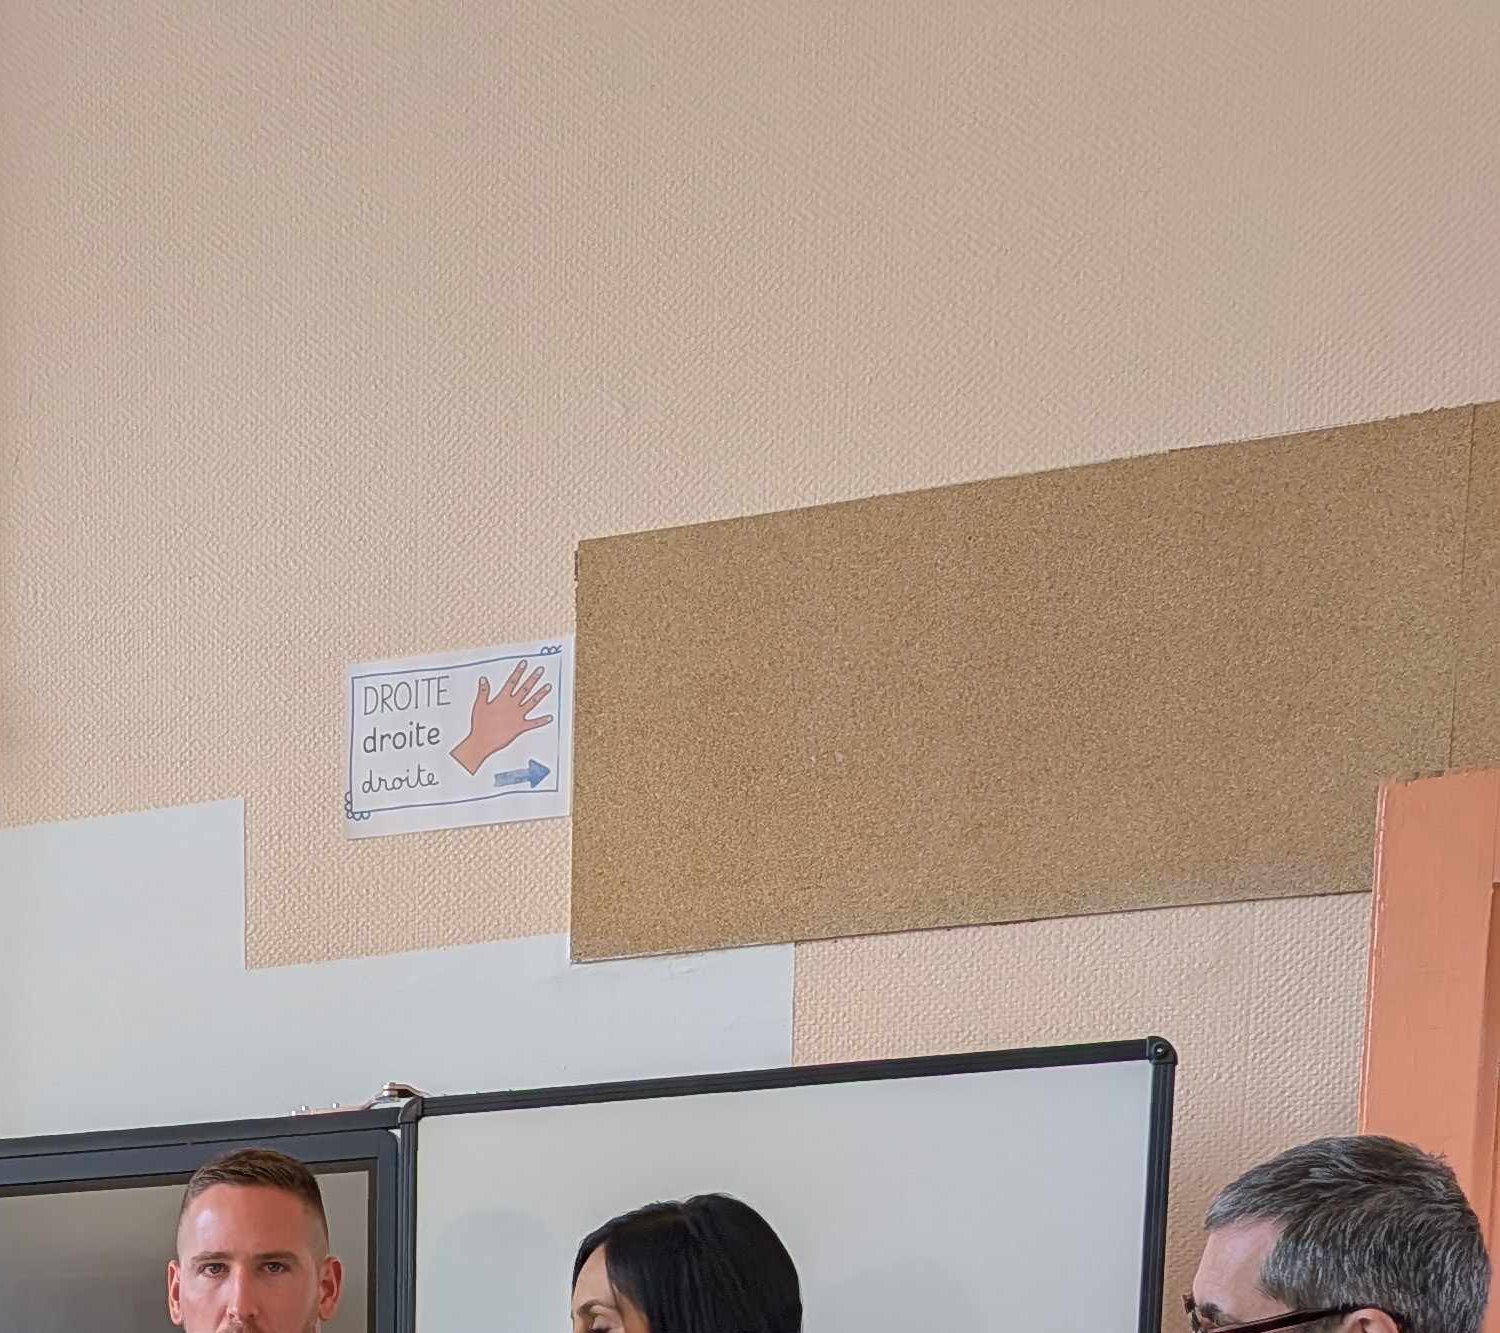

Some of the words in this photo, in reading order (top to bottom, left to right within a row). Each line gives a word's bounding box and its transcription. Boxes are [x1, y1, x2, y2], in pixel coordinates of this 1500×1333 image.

[363, 675, 451, 715] DROITE
[362, 721, 441, 753] droite
[361, 764, 440, 794] droite
